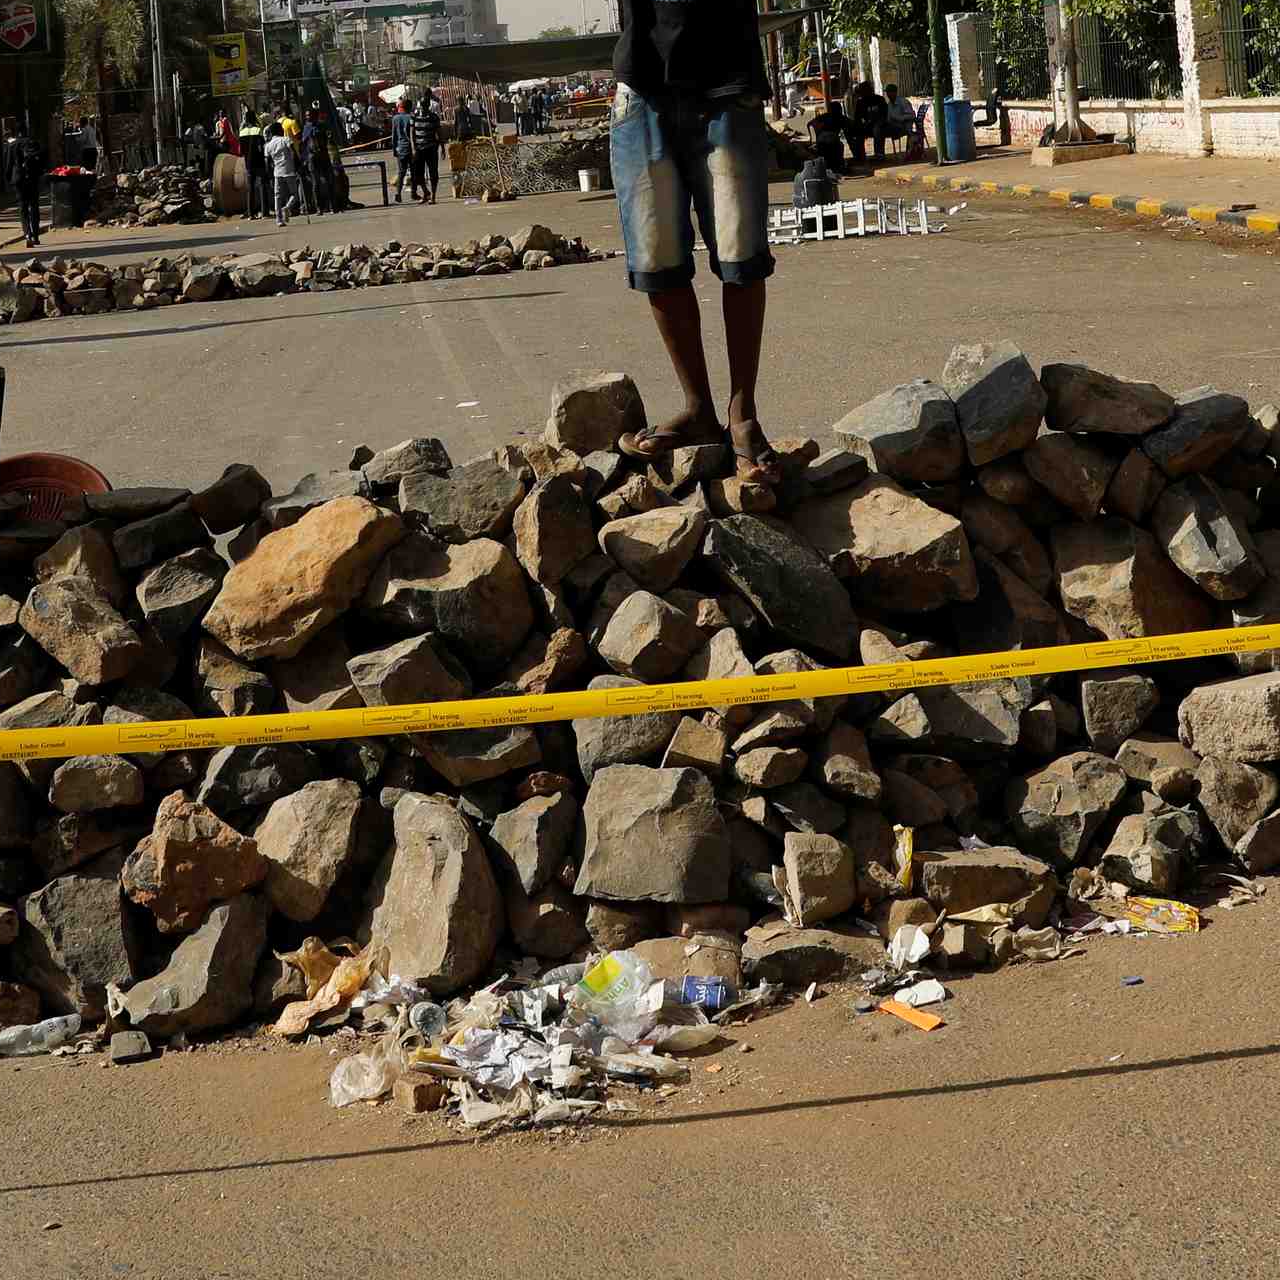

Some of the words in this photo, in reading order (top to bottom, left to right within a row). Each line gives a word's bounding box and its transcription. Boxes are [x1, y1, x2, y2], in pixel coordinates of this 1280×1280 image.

[676, 693, 702, 702] Warning
[648, 702, 671, 712] Optical
[432, 712, 459, 722] Warning
[404, 723, 428, 732] Optical
